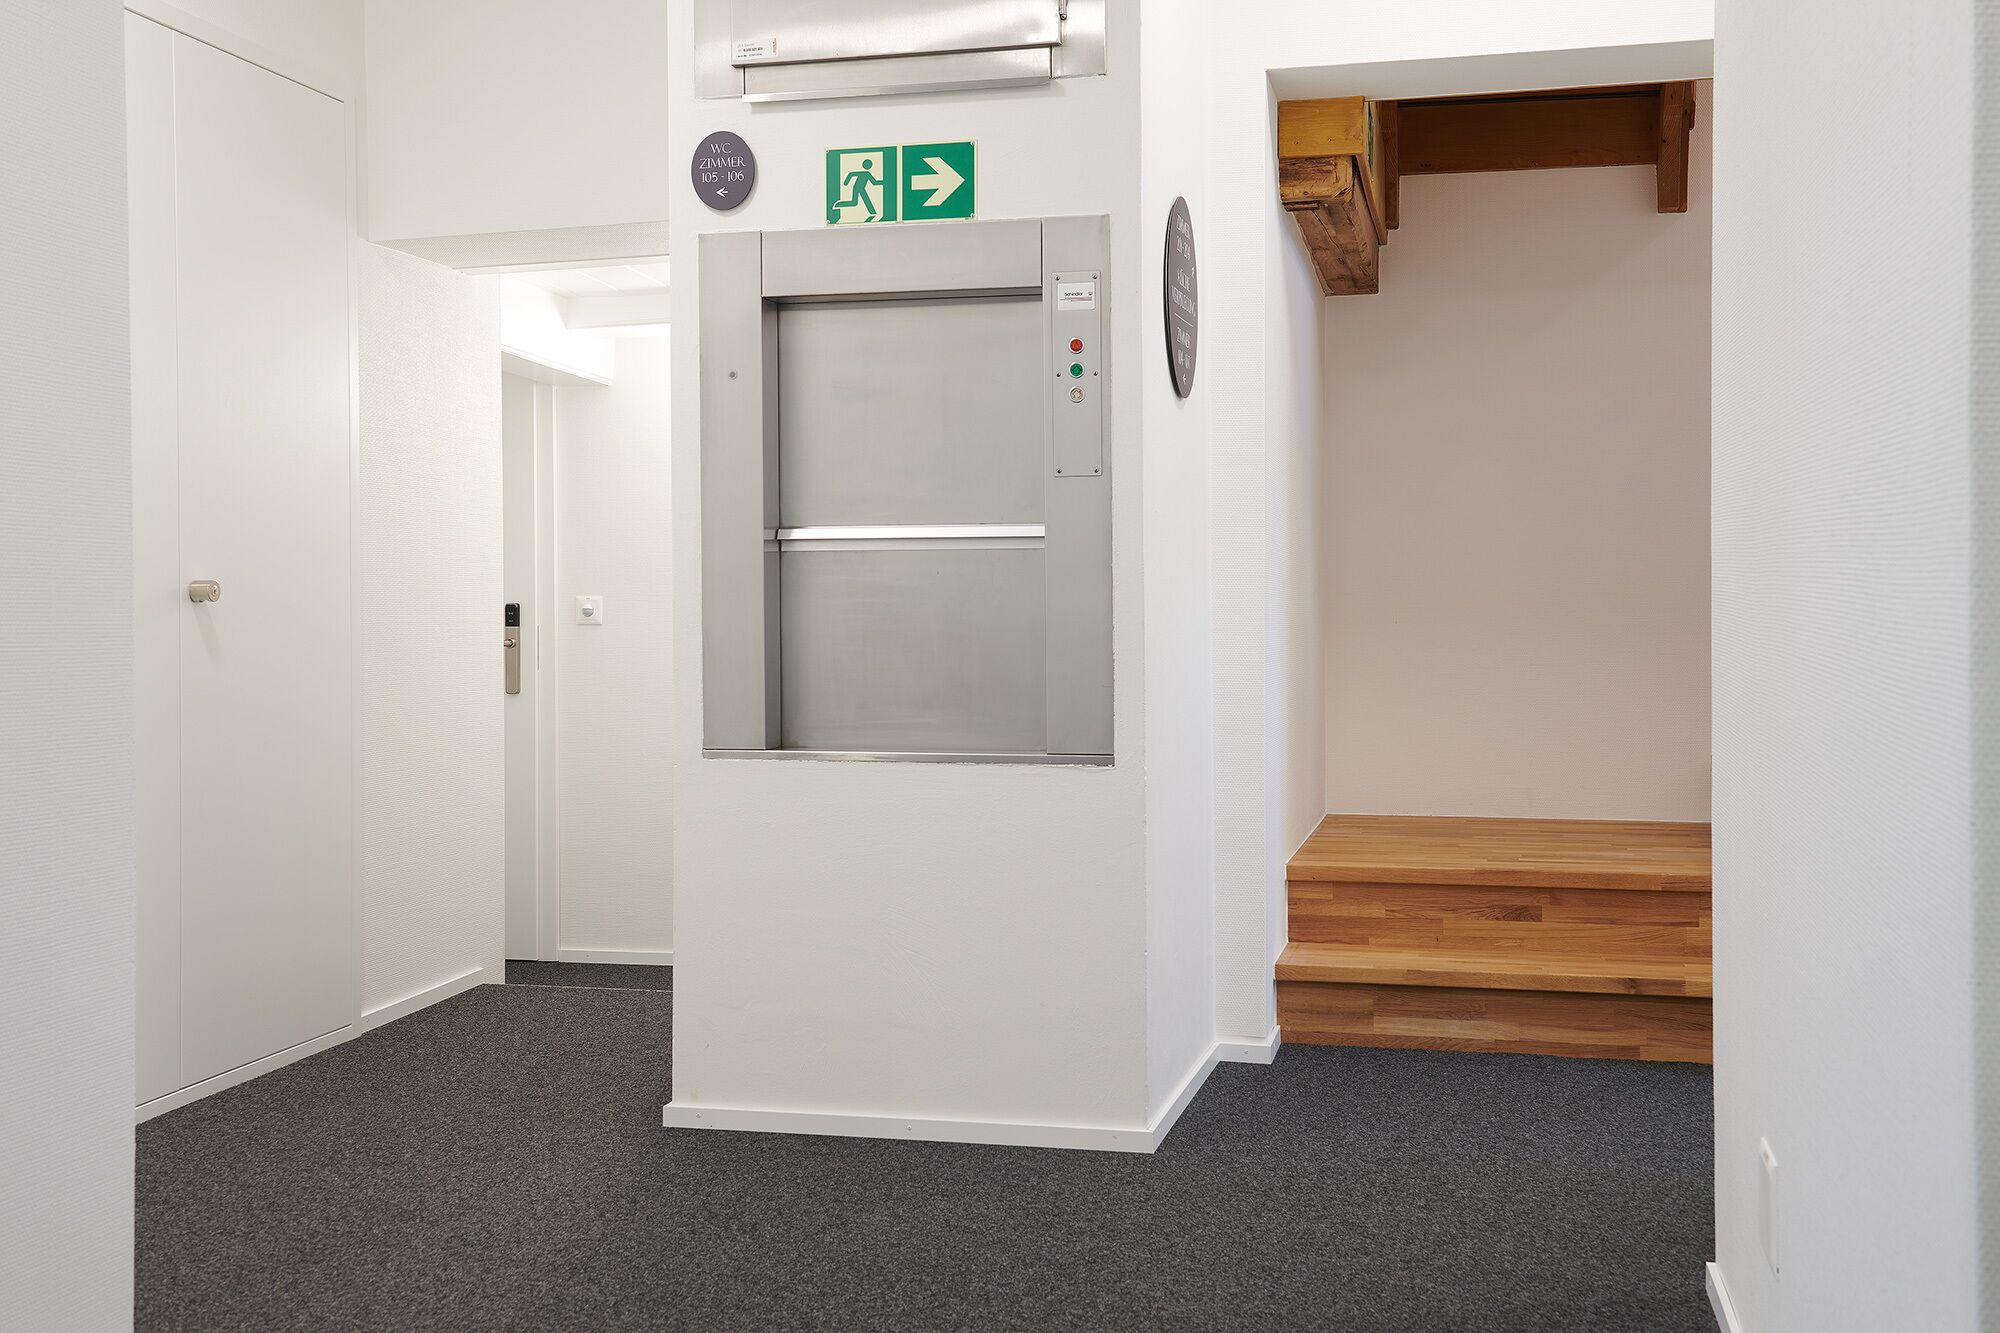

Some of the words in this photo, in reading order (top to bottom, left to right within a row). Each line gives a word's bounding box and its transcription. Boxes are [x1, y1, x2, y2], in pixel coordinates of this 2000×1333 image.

[710, 142, 732, 154] WC
[699, 156, 746, 169] ZIMMER
[702, 171, 718, 183] 105
[727, 170, 744, 182] 106
